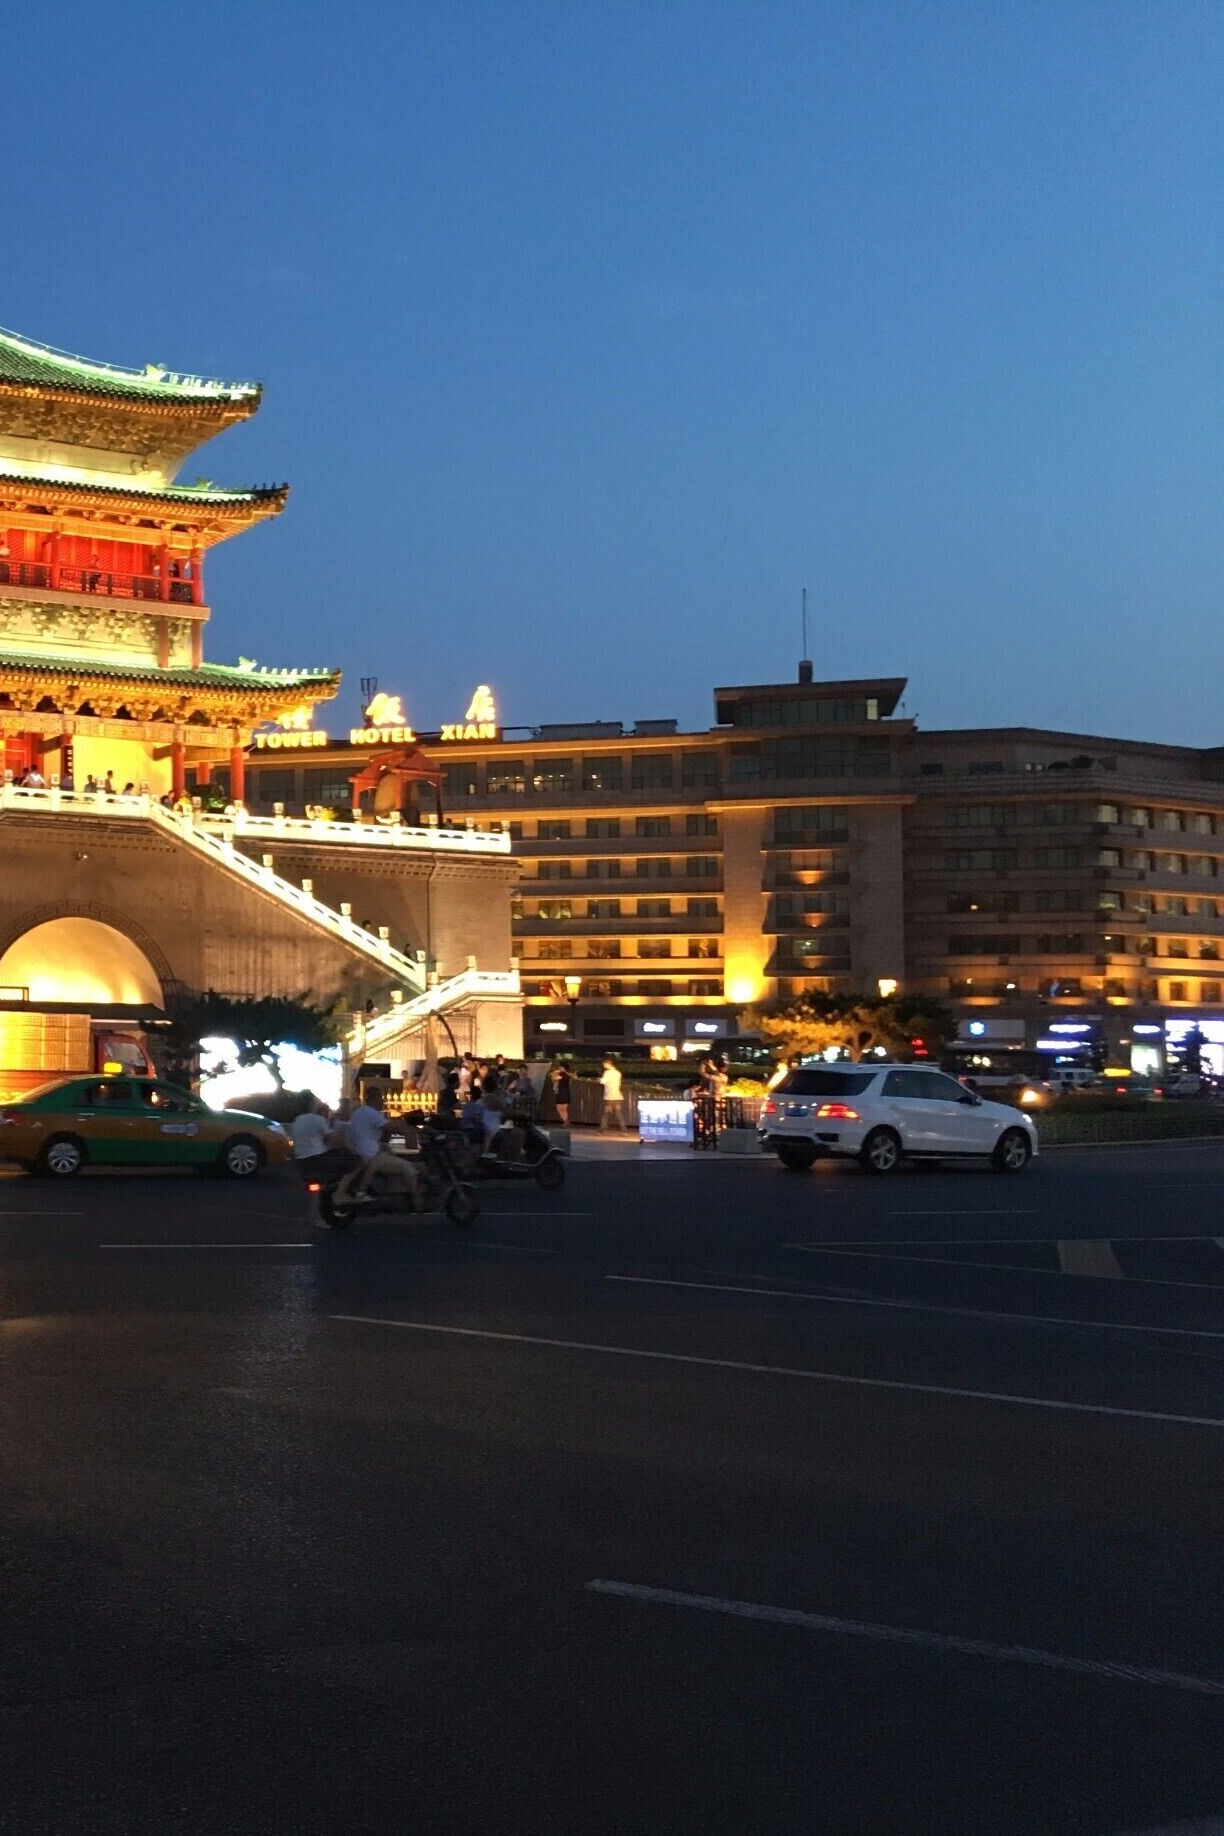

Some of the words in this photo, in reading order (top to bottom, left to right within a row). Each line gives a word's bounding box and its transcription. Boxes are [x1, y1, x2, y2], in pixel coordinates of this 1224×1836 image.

[254, 731, 327, 749] TOWER
[350, 727, 417, 745] HOTEL
[440, 723, 497, 741] XIAN
